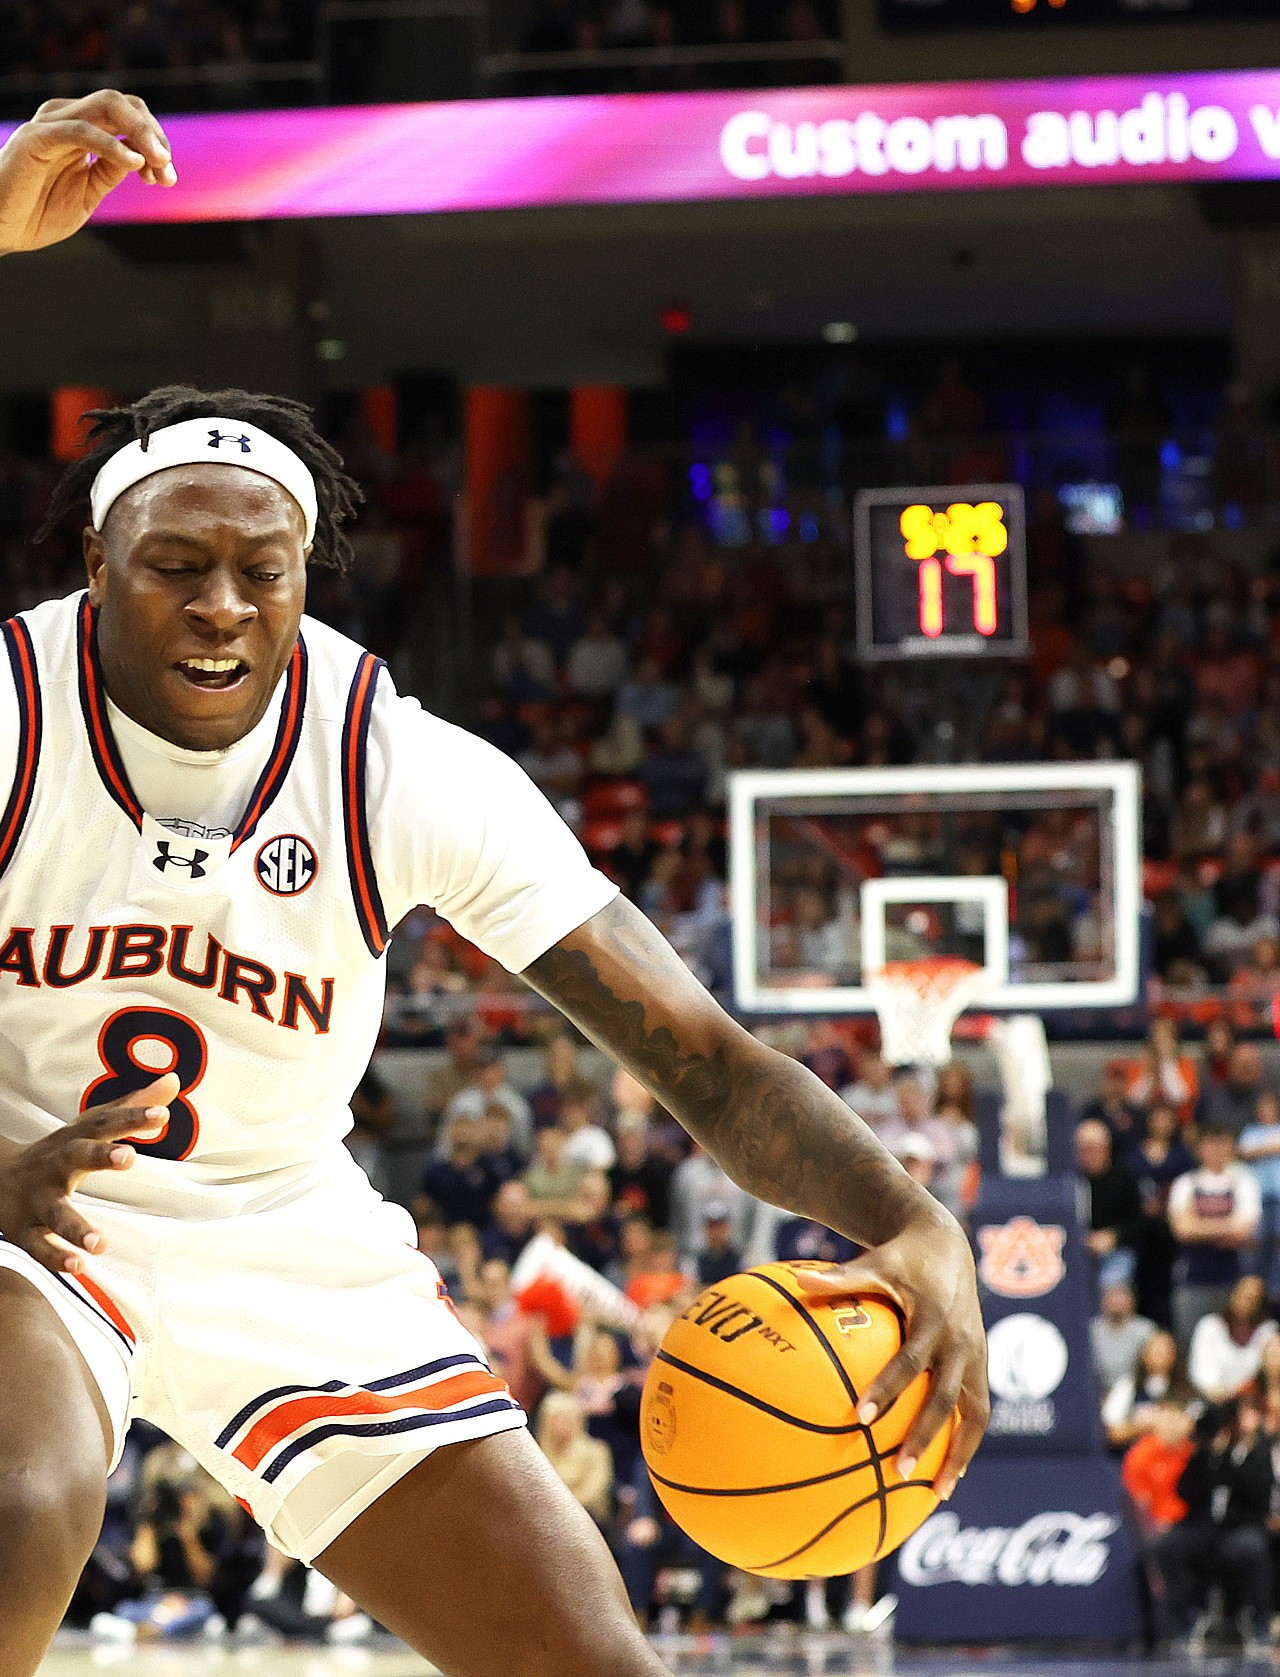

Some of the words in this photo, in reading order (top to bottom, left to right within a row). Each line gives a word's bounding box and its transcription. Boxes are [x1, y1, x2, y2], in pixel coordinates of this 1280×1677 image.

[721, 111, 1007, 181] Custom
[1022, 91, 1238, 168] audio
[919, 554, 998, 638] 17
[259, 836, 315, 893] SEC
[80, 1006, 208, 1161] 8
[759, 1326, 797, 1353] NXT
